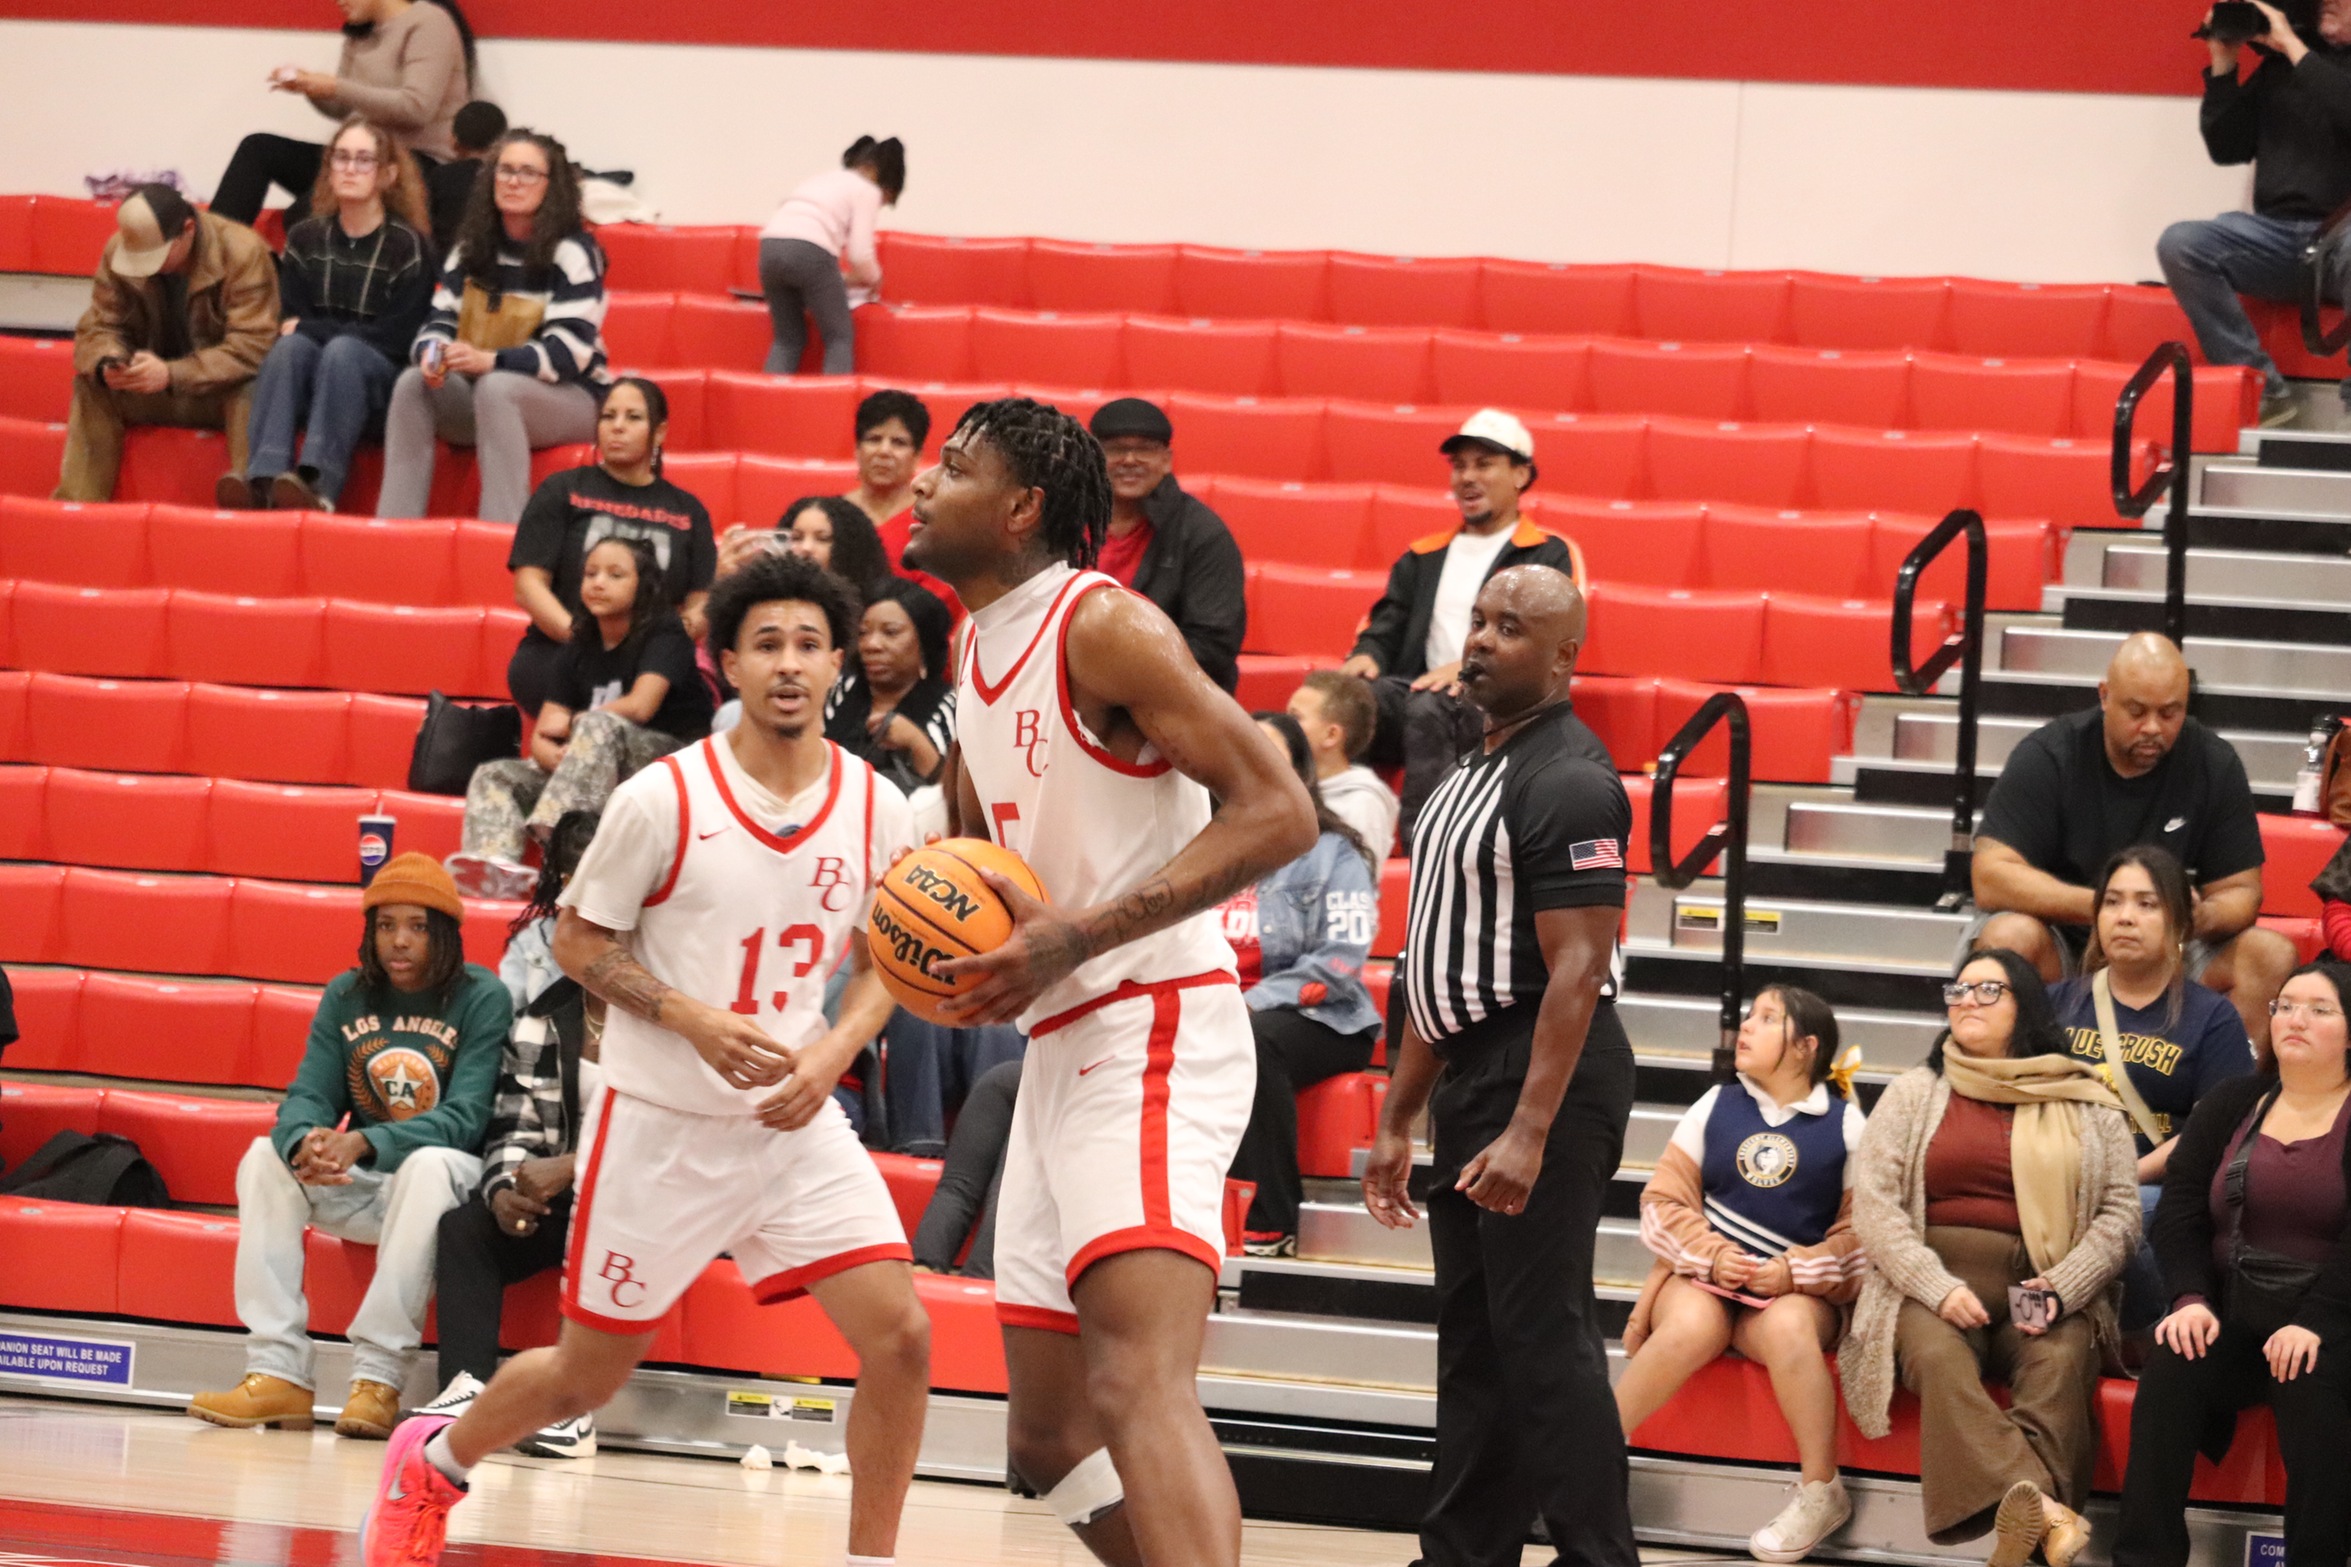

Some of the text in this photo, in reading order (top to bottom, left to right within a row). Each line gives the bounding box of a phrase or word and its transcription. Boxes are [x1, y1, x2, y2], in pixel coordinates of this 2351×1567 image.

[808, 856, 849, 912] BC
[904, 863, 981, 924] NCAA
[730, 923, 825, 1015] 13
[341, 1014, 381, 1041] LOS
[385, 1080, 416, 1099] CA
[597, 1249, 647, 1308] BC
[31, 1343, 55, 1357] SEAT
[56, 1346, 78, 1360] WILL
[80, 1349, 94, 1361] BE
[95, 1350, 122, 1364] MADE
[37, 1359, 64, 1372] UPON
[65, 1361, 109, 1376] REQUEST
